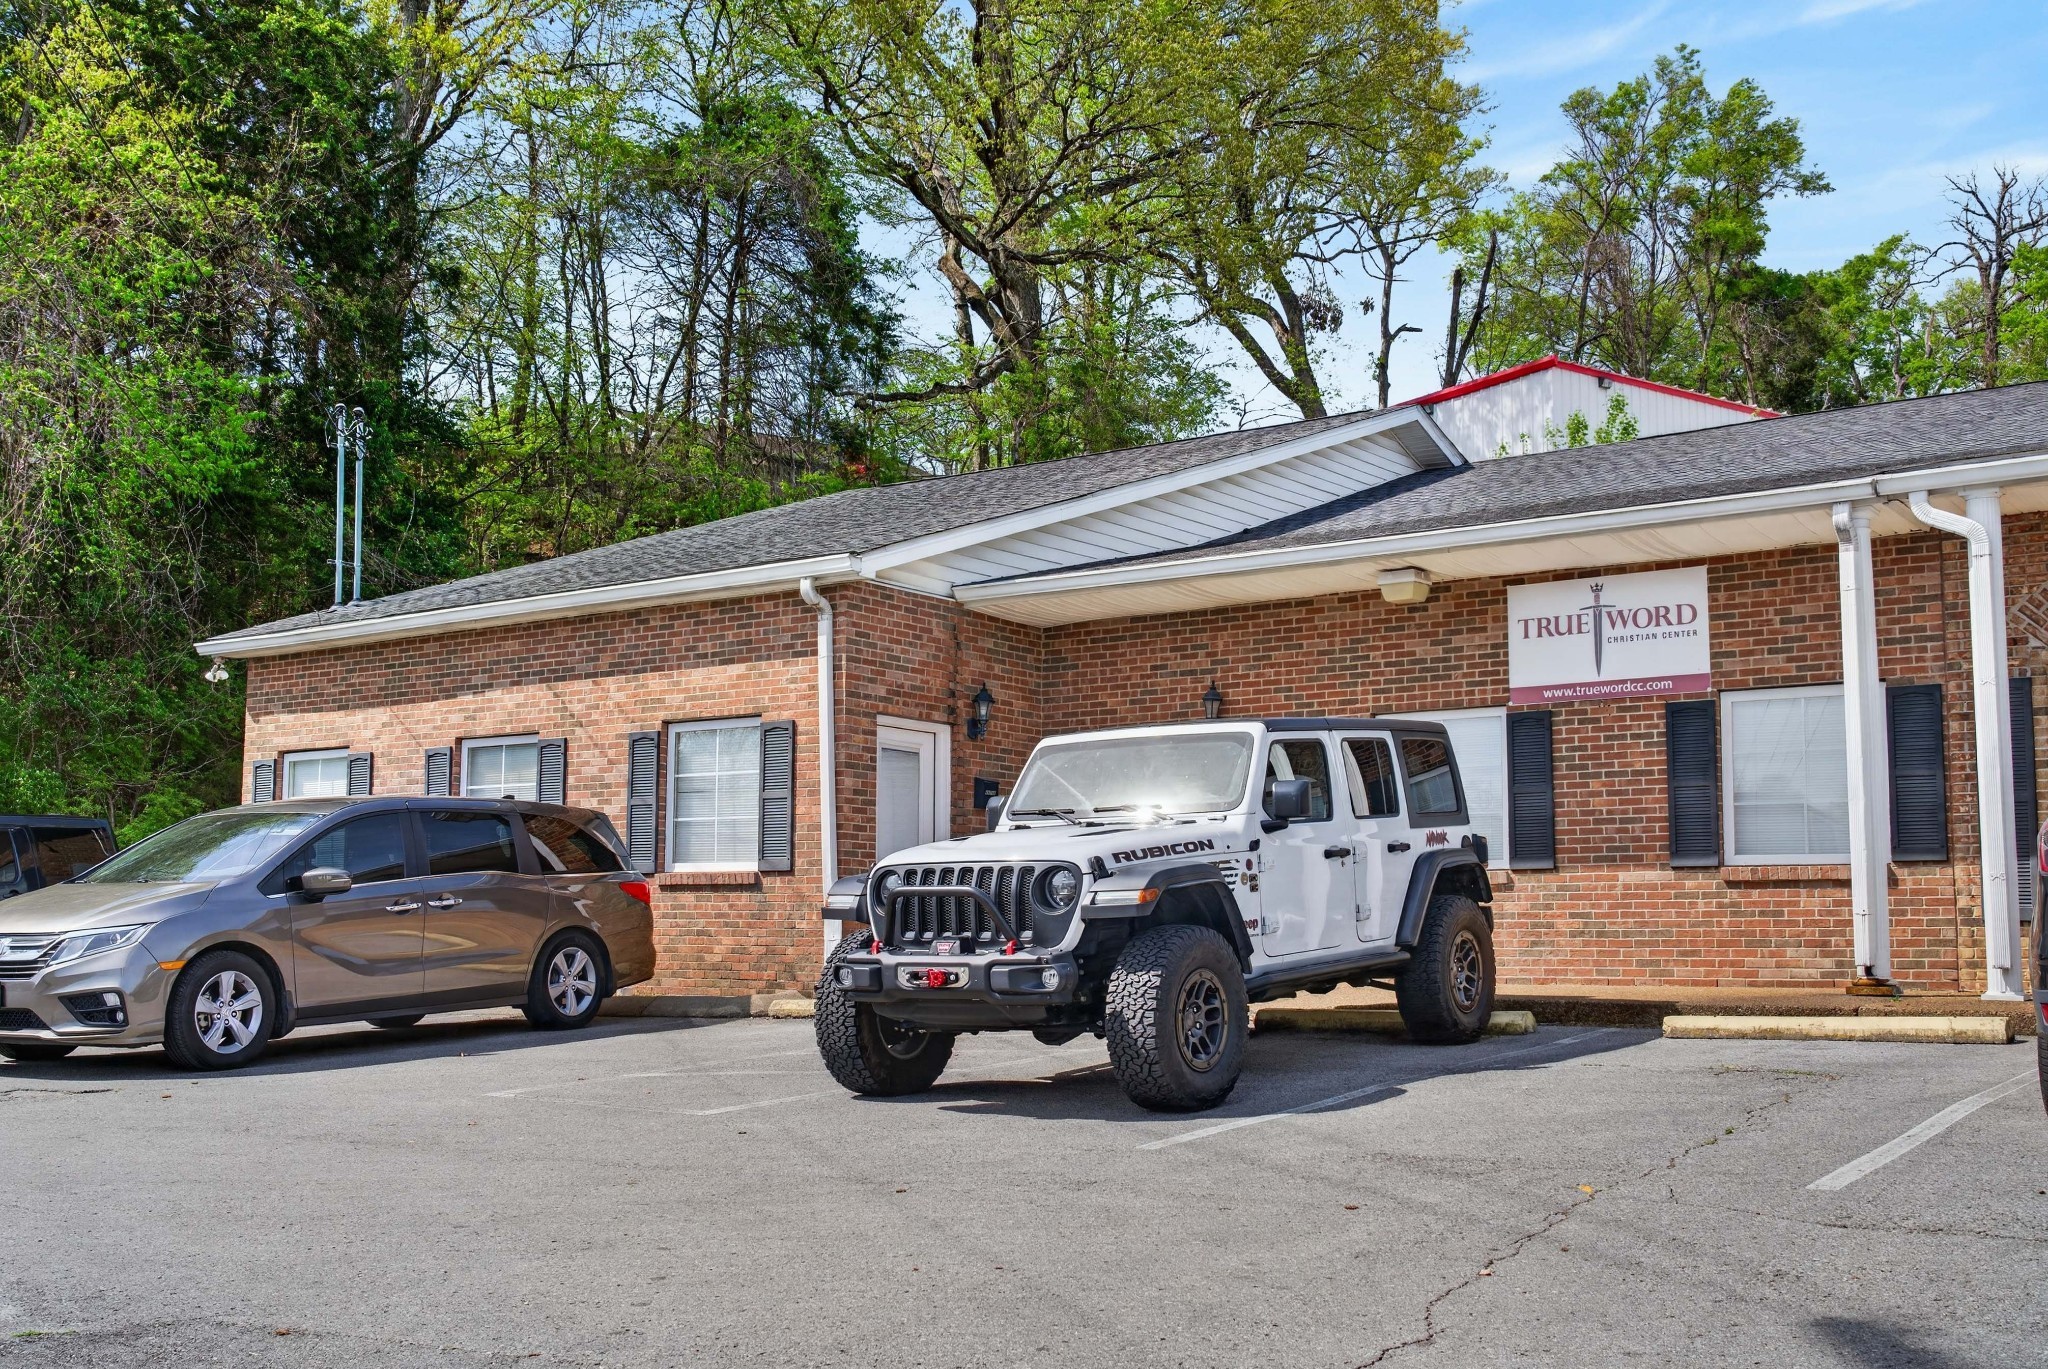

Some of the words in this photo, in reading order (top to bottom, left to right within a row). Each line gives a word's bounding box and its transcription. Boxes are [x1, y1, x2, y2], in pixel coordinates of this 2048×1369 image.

[1517, 613, 1590, 640] TRUE
[1605, 603, 1698, 631] WORD
[1607, 632, 1658, 644] CHRISTIAN
[1662, 629, 1698, 639] CENTER
[1543, 680, 1673, 698] www.truewordcc.com
[1111, 839, 1215, 863] RUBICON
[1244, 918, 1259, 931] eep
